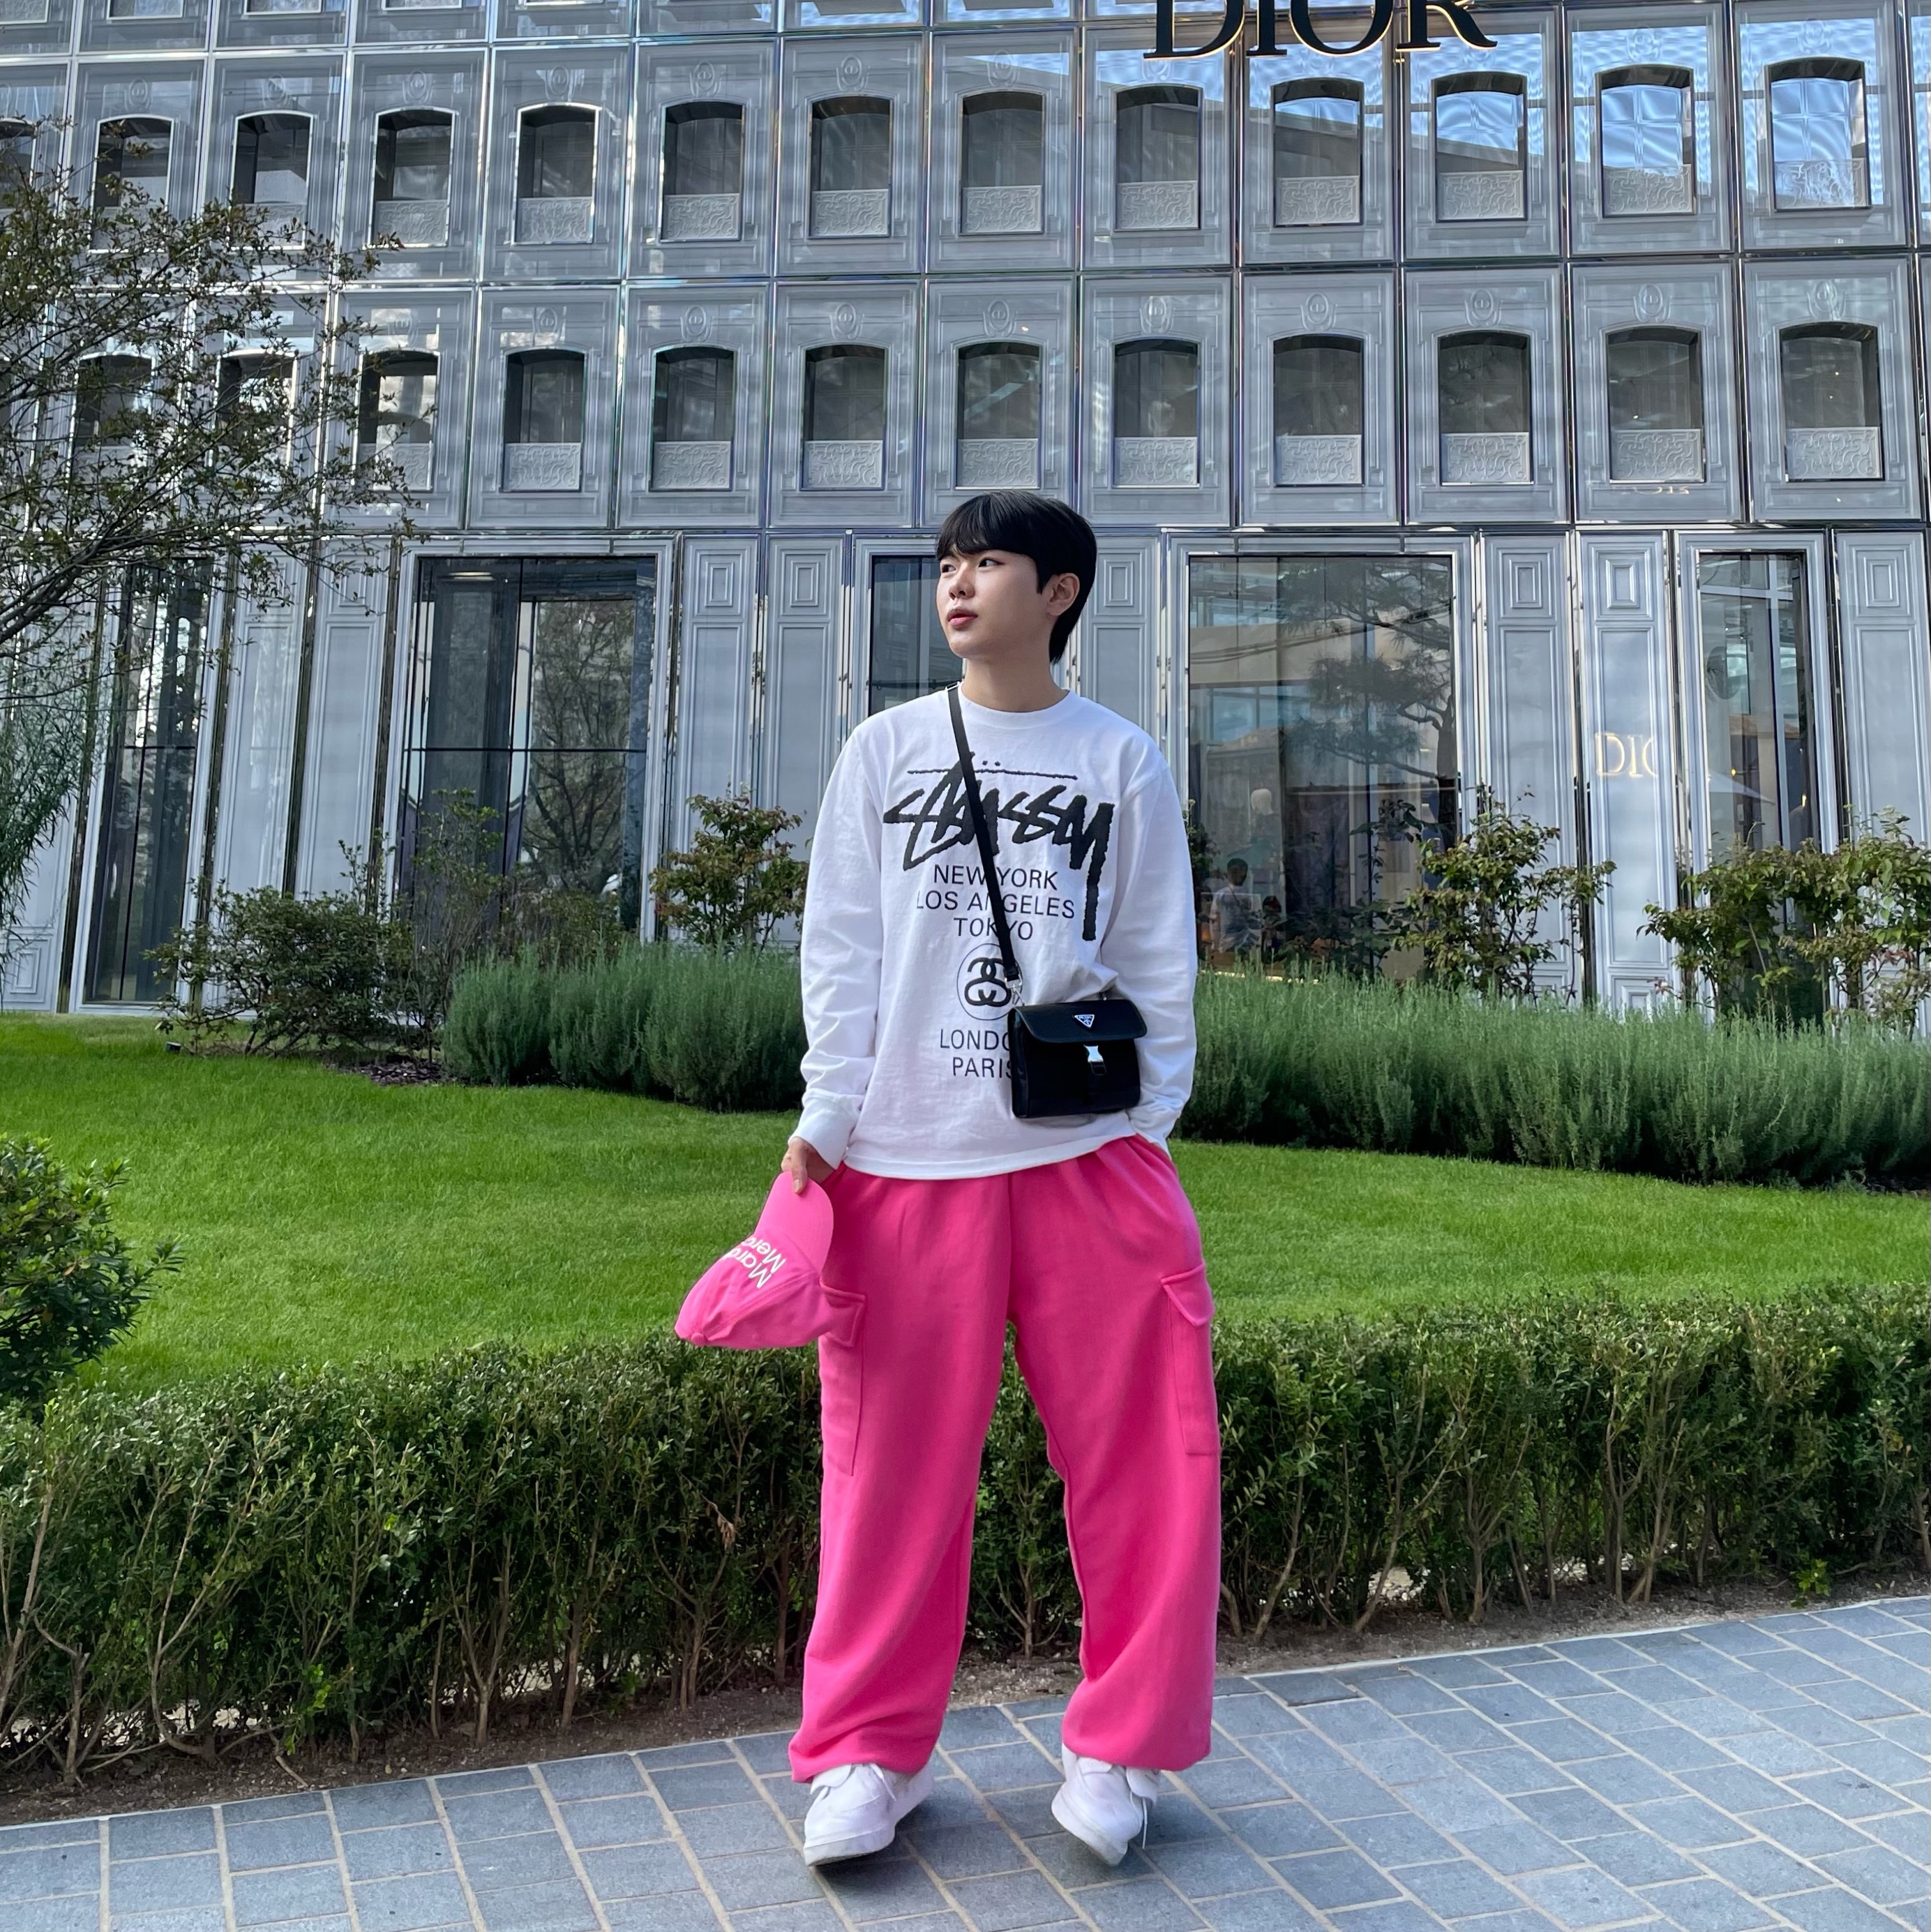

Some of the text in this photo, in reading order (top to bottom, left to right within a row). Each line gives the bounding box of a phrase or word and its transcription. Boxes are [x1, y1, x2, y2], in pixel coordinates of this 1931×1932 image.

[933, 864, 1058, 890] NEW YORK
[916, 890, 959, 911] LOS
[722, 1248, 772, 1289] Mard
